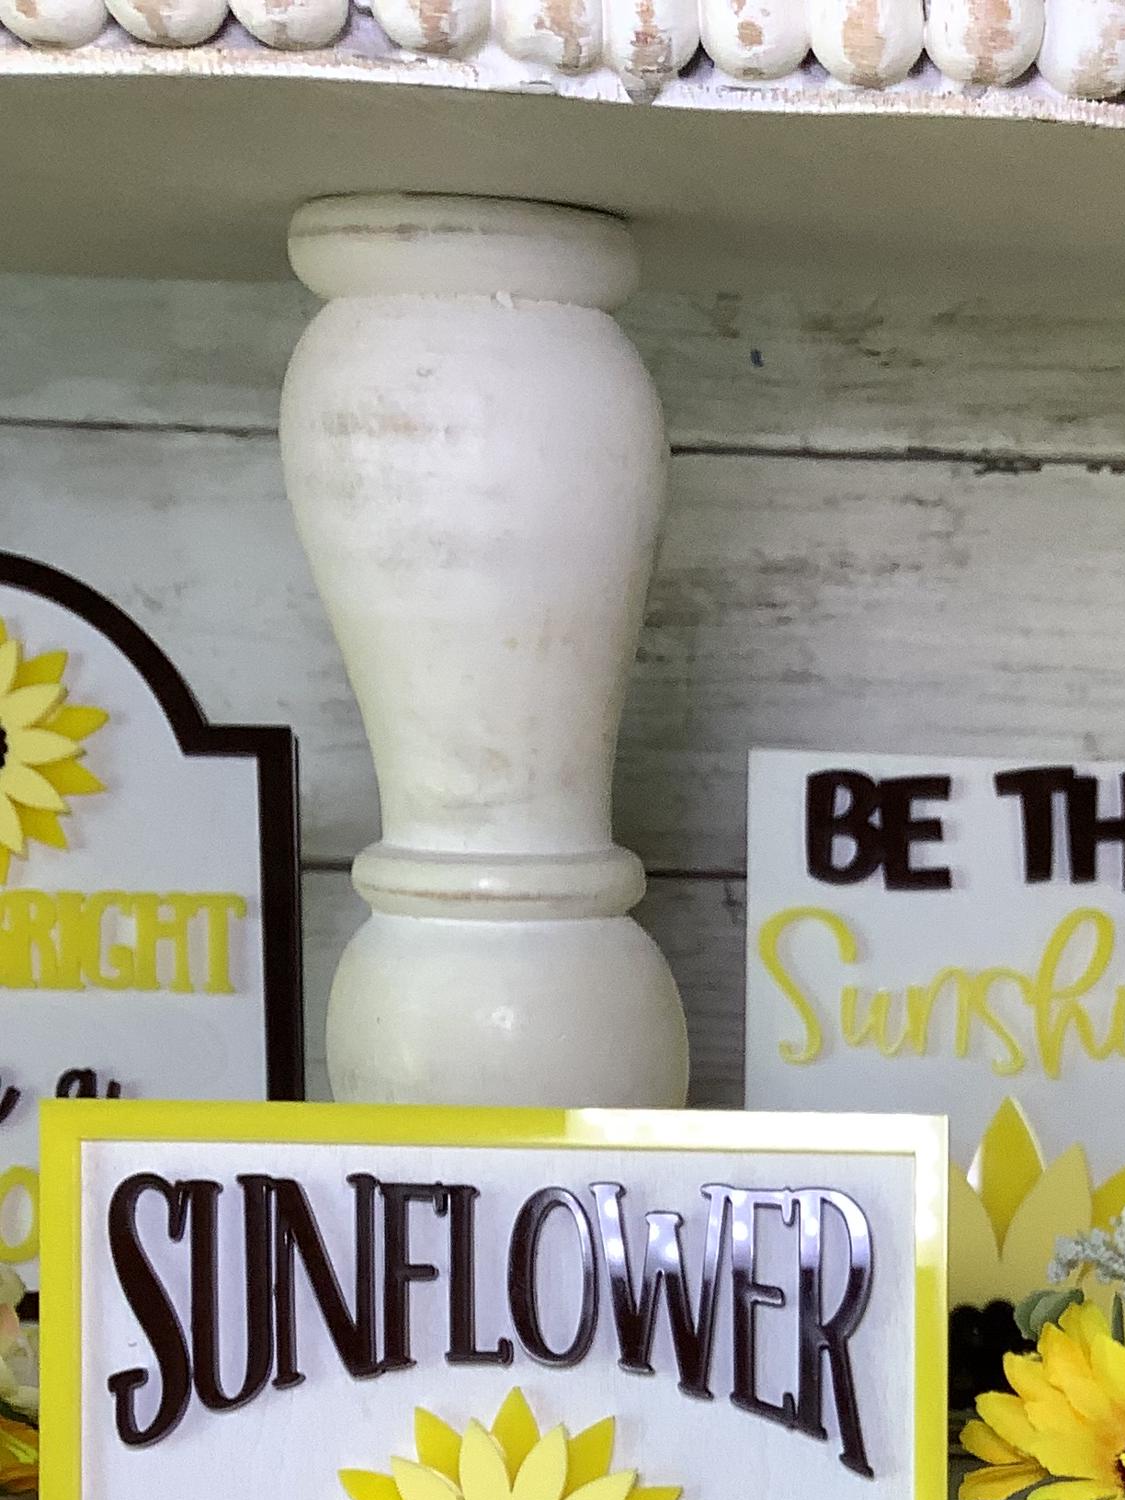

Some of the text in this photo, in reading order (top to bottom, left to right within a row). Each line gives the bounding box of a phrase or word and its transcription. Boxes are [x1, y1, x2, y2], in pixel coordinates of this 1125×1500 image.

[806, 769, 951, 890] BE
[0, 889, 246, 994] RIGHT
[107, 1172, 875, 1478] SUNFLOWER
